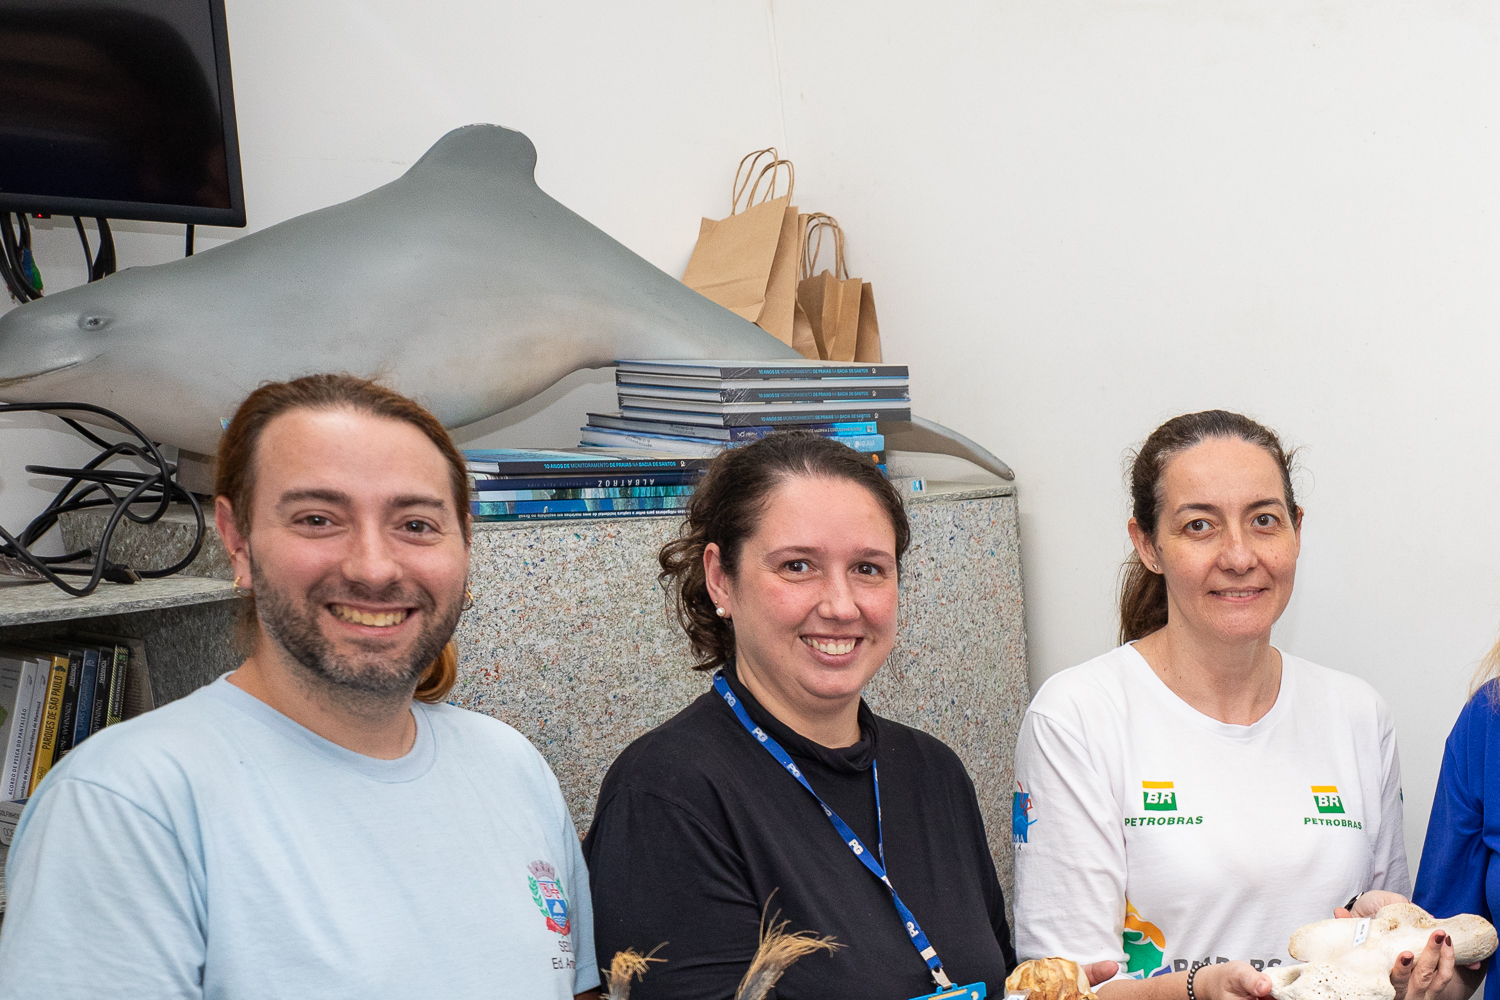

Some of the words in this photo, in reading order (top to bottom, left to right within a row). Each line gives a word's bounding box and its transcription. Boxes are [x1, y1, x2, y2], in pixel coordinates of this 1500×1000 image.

[598, 479, 655, 487] ALBATROZ
[52, 676, 62, 696] PAULO
[724, 691, 736, 707] PG
[47, 712, 57, 720] DE
[42, 720, 56, 750] PARQUES
[751, 726, 768, 742] PG
[8, 773, 16, 795] ACORDO
[18, 709, 27, 739] PANTALEÃO
[787, 763, 800, 778] PG
[1146, 792, 1174, 804] BR
[1318, 796, 1340, 807] BR
[1124, 816, 1203, 827] PETROBRAS
[1304, 817, 1362, 830] PETROBRAS
[848, 839, 864, 855] PG
[906, 921, 919, 938] PG
